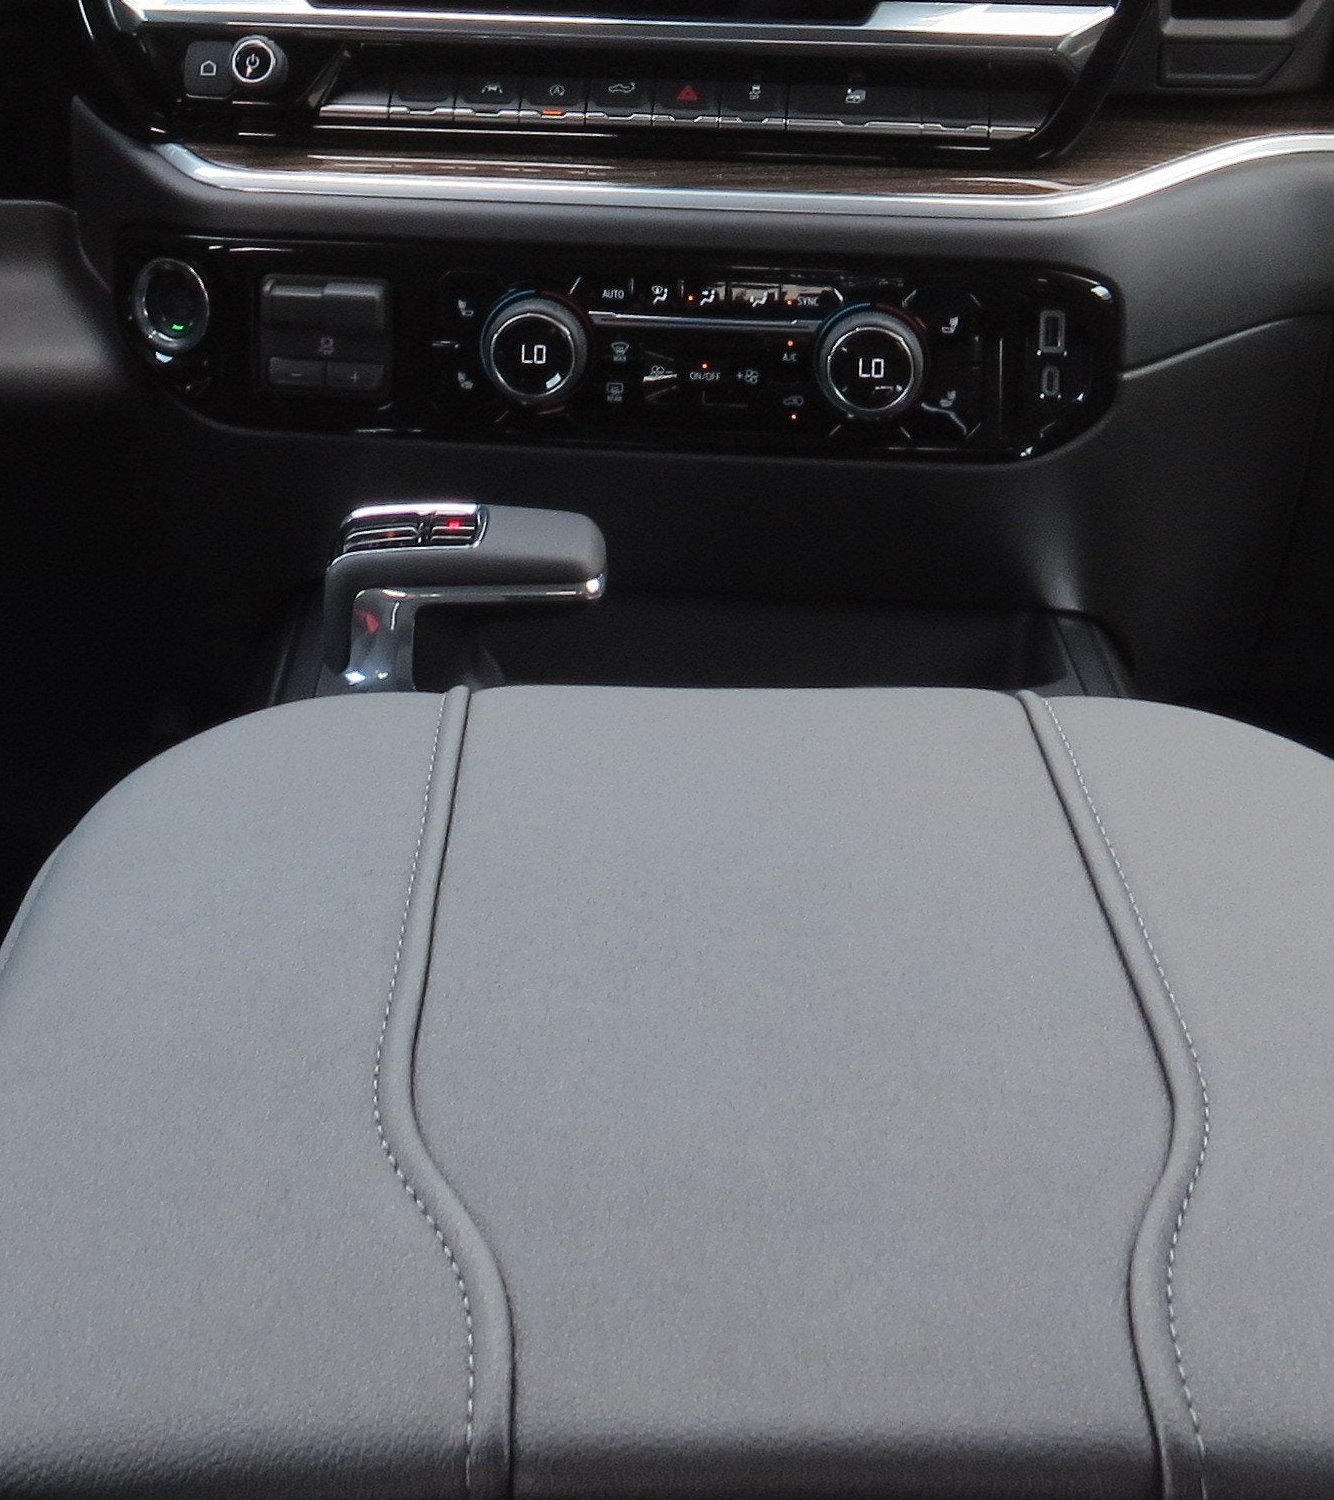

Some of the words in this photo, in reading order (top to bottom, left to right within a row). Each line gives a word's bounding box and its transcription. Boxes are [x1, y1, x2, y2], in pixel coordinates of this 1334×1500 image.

[601, 289, 625, 300] AUTO
[797, 296, 819, 307] SYNC
[521, 344, 547, 365] LO
[858, 358, 885, 378] LO
